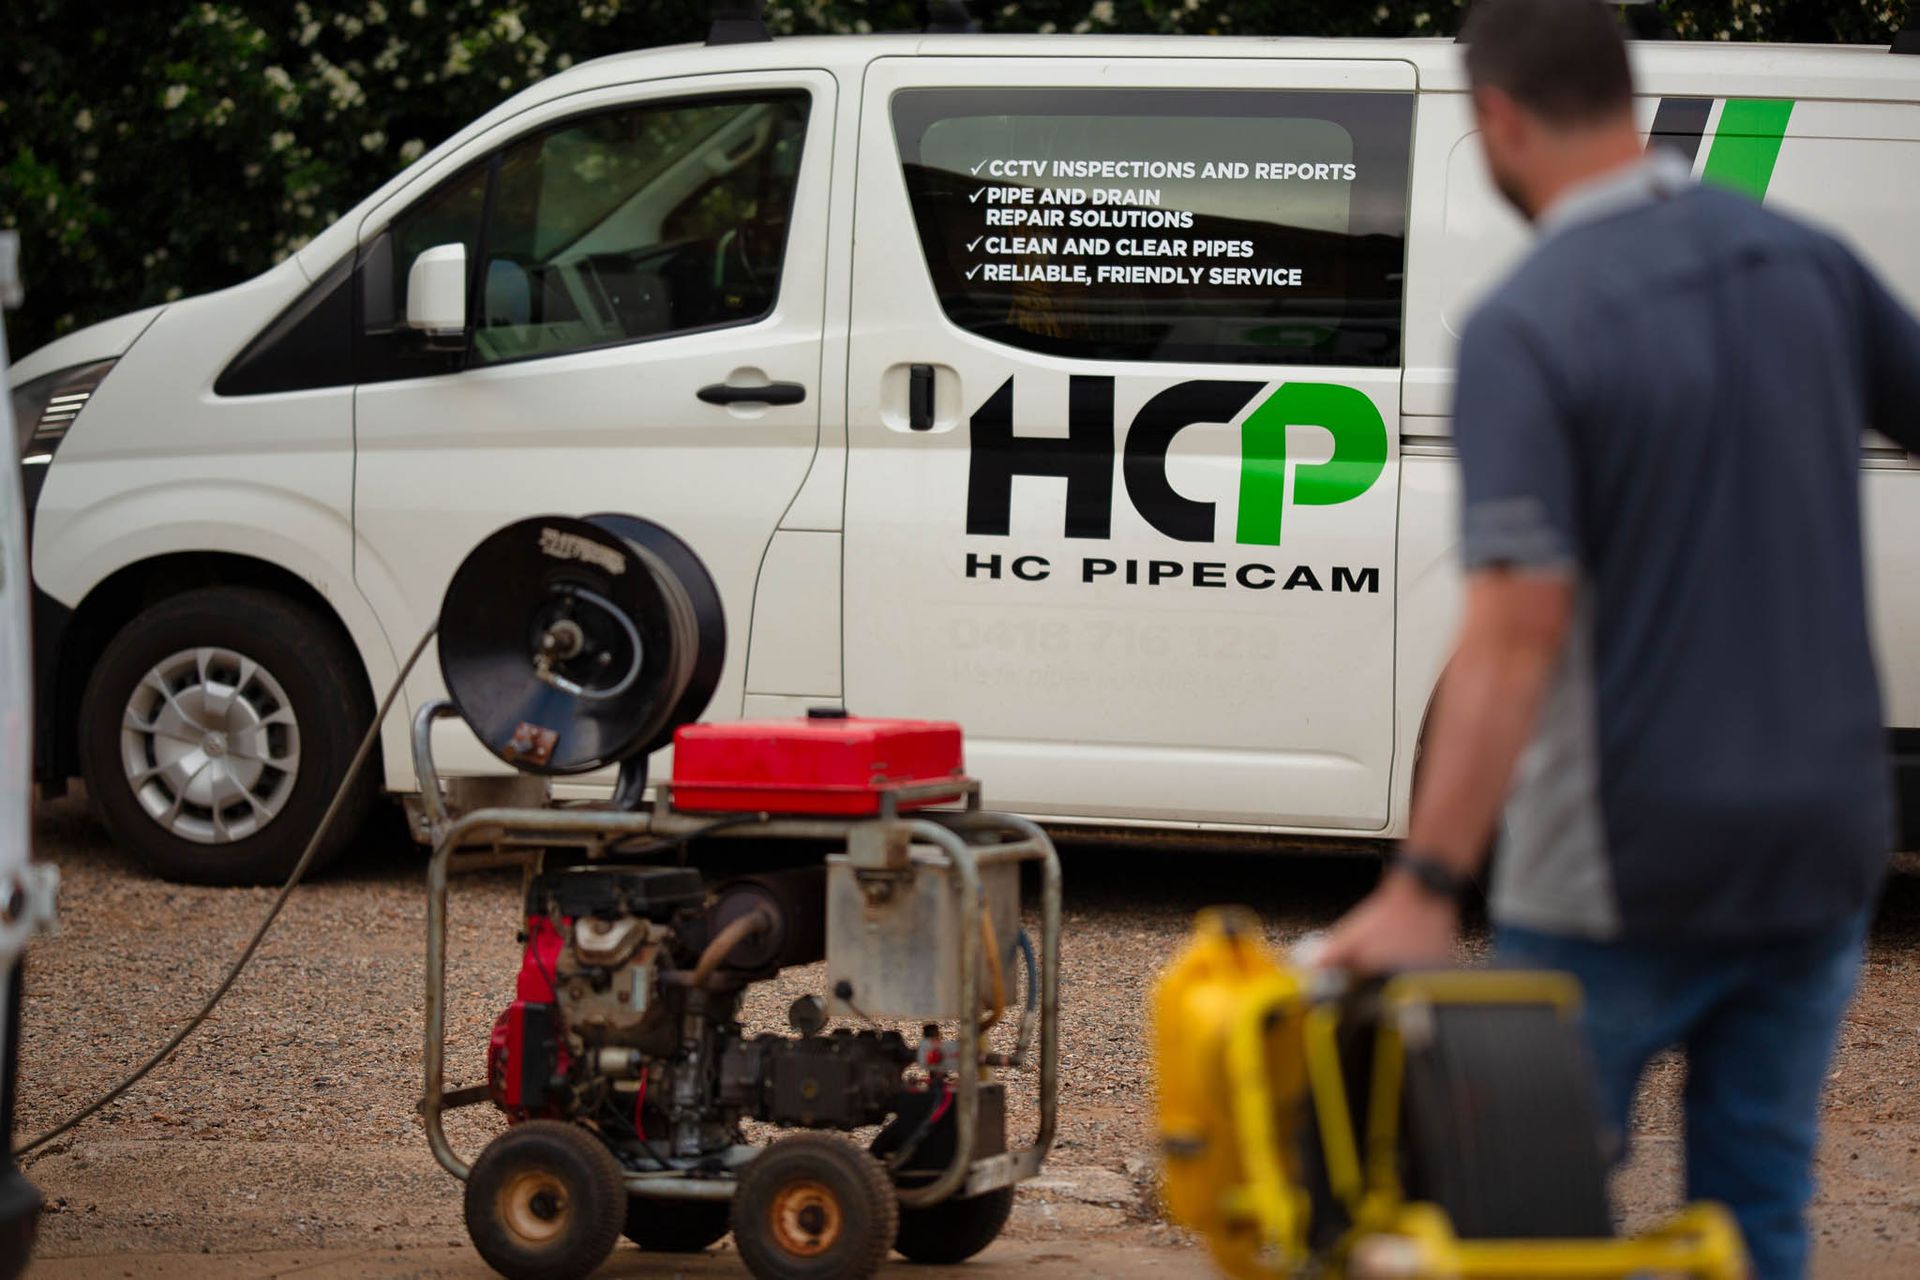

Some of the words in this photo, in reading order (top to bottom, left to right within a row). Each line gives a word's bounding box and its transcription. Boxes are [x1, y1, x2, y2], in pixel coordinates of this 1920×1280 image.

[989, 160, 1048, 177] CCTV
[1052, 160, 1196, 179] INSPECTIONS
[1200, 162, 1250, 180] AND
[1254, 162, 1357, 181] REPORTS
[987, 187, 1034, 204] PIPE
[1038, 188, 1087, 205] AND
[1091, 189, 1161, 206] DRAIN
[986, 209, 1066, 227] REPAIR
[1069, 209, 1195, 229] SOLUTIONS
[984, 236, 1058, 255] CLEAN
[1062, 237, 1111, 256] AND
[1115, 238, 1189, 258] CLEAR
[1192, 240, 1255, 259] PIPES
[983, 263, 1092, 286] RELIABLE,
[1097, 265, 1206, 285] FRIENDLY
[1208, 266, 1302, 287] SERVICE
[966, 374, 1388, 546] HCP
[965, 553, 1050, 581] HC
[1082, 558, 1380, 593] PIPECAM
